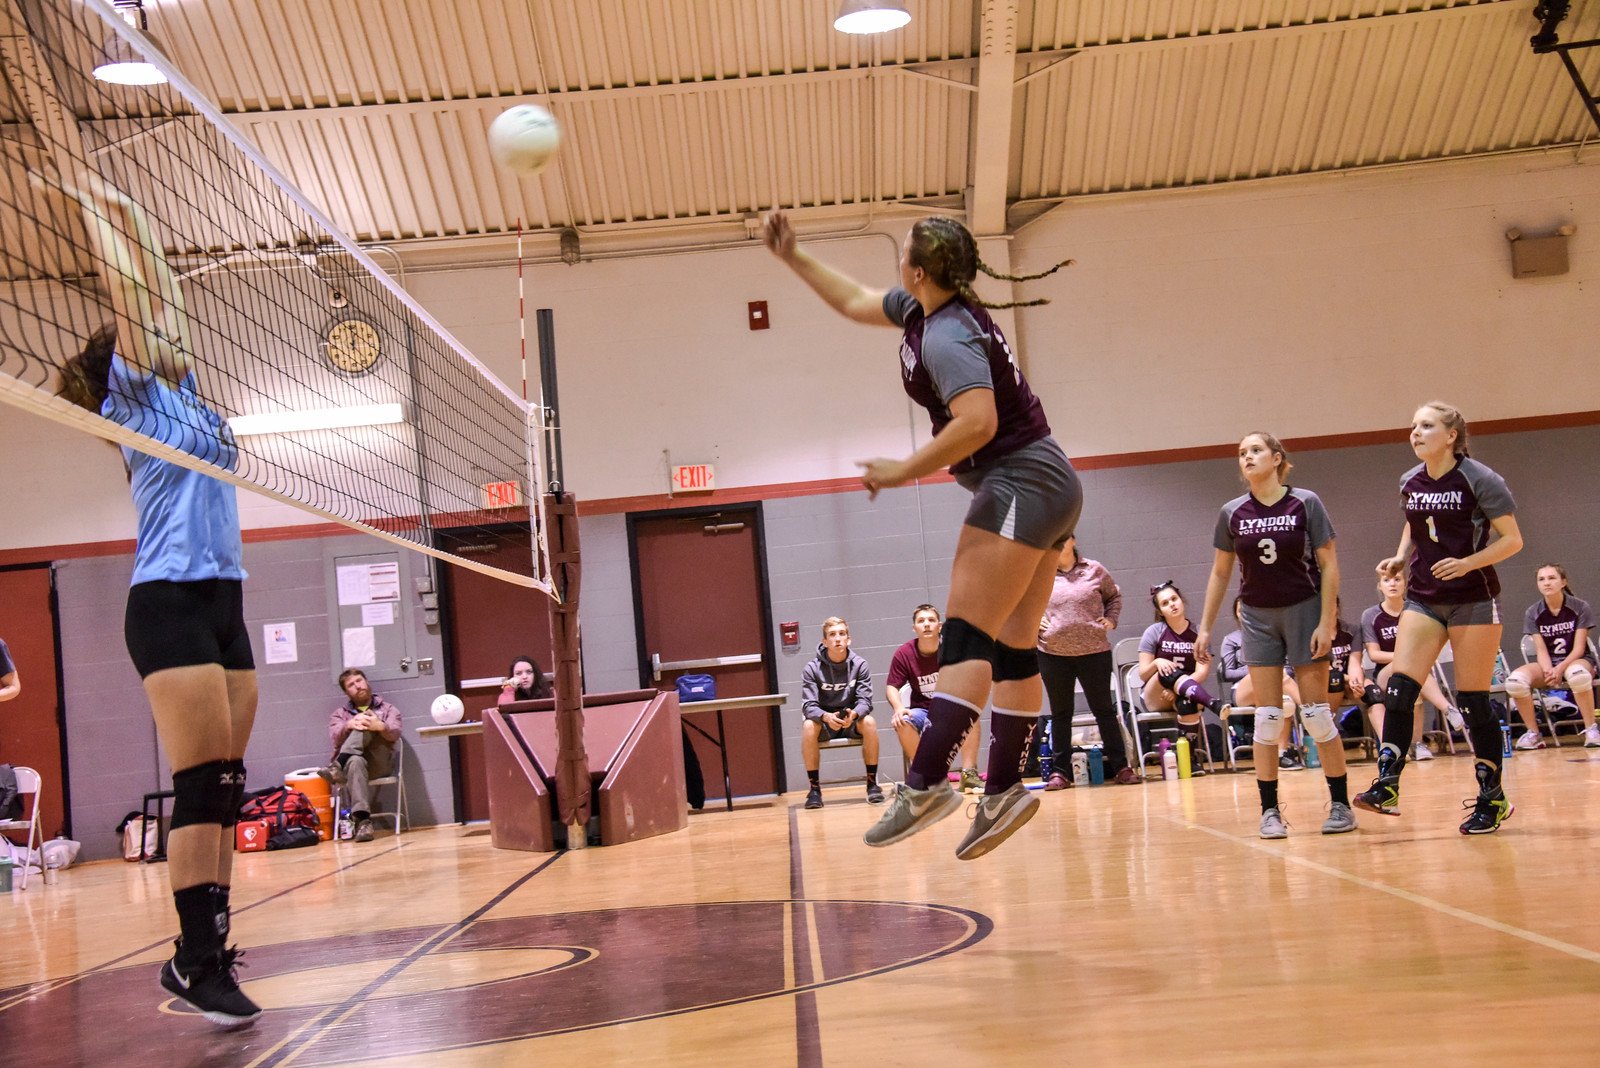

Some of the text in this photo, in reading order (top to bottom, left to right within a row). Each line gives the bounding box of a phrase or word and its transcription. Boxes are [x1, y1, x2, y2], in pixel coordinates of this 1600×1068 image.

[679, 465, 707, 488] EXIT
[487, 482, 516, 507] EXIT
[1408, 491, 1462, 504] LYNDON
[1238, 526, 1296, 536] VOLLEYBALL
[1239, 515, 1297, 531] LYNDON
[1426, 516, 1439, 543] 1
[1257, 538, 1277, 564] 3
[1540, 621, 1575, 633] LYNDON
[1553, 638, 1566, 654] 2
[1173, 656, 1185, 670] 5
